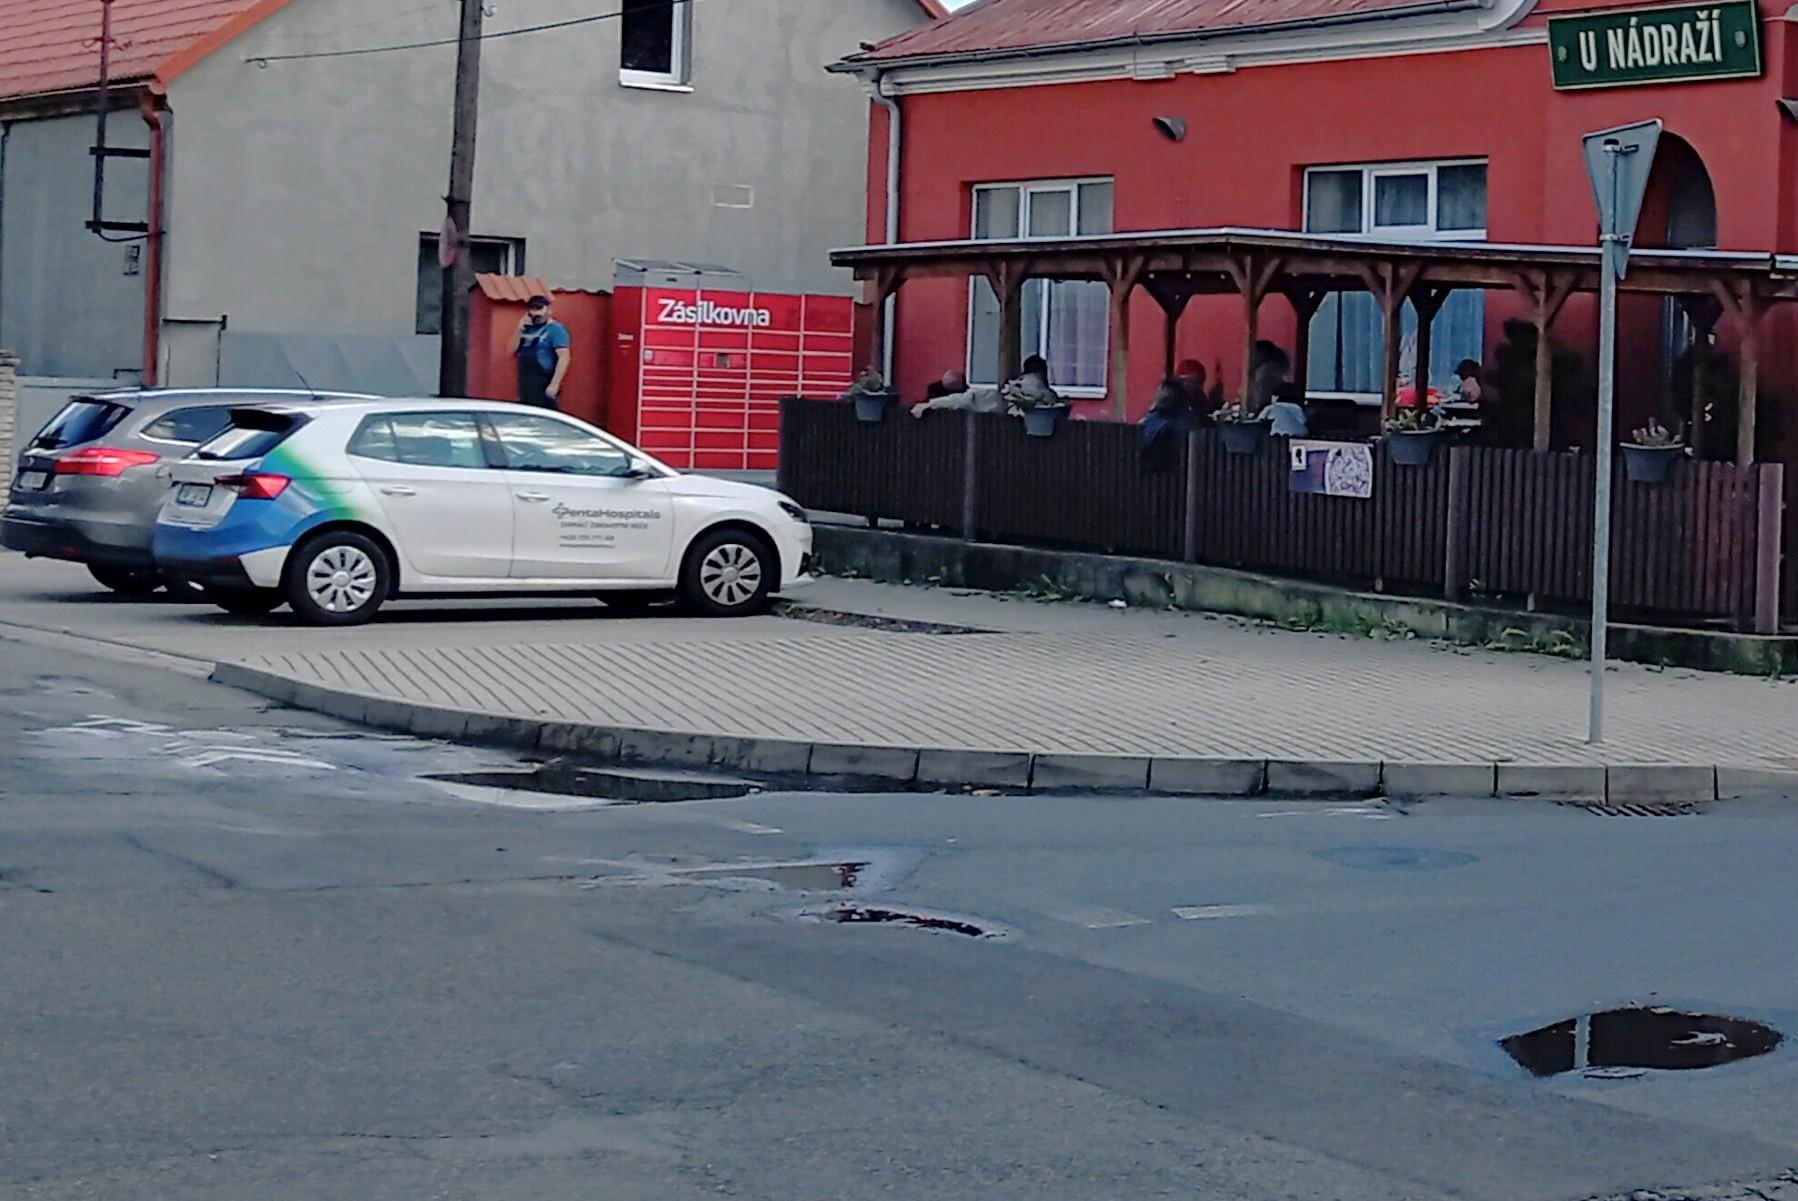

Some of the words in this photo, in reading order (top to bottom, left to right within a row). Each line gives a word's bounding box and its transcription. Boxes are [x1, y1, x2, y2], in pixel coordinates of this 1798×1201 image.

[1579, 30, 1598, 72] U
[1607, 8, 1723, 70] NÁDRAŽÍ
[657, 298, 771, 327] Zásilkovna
